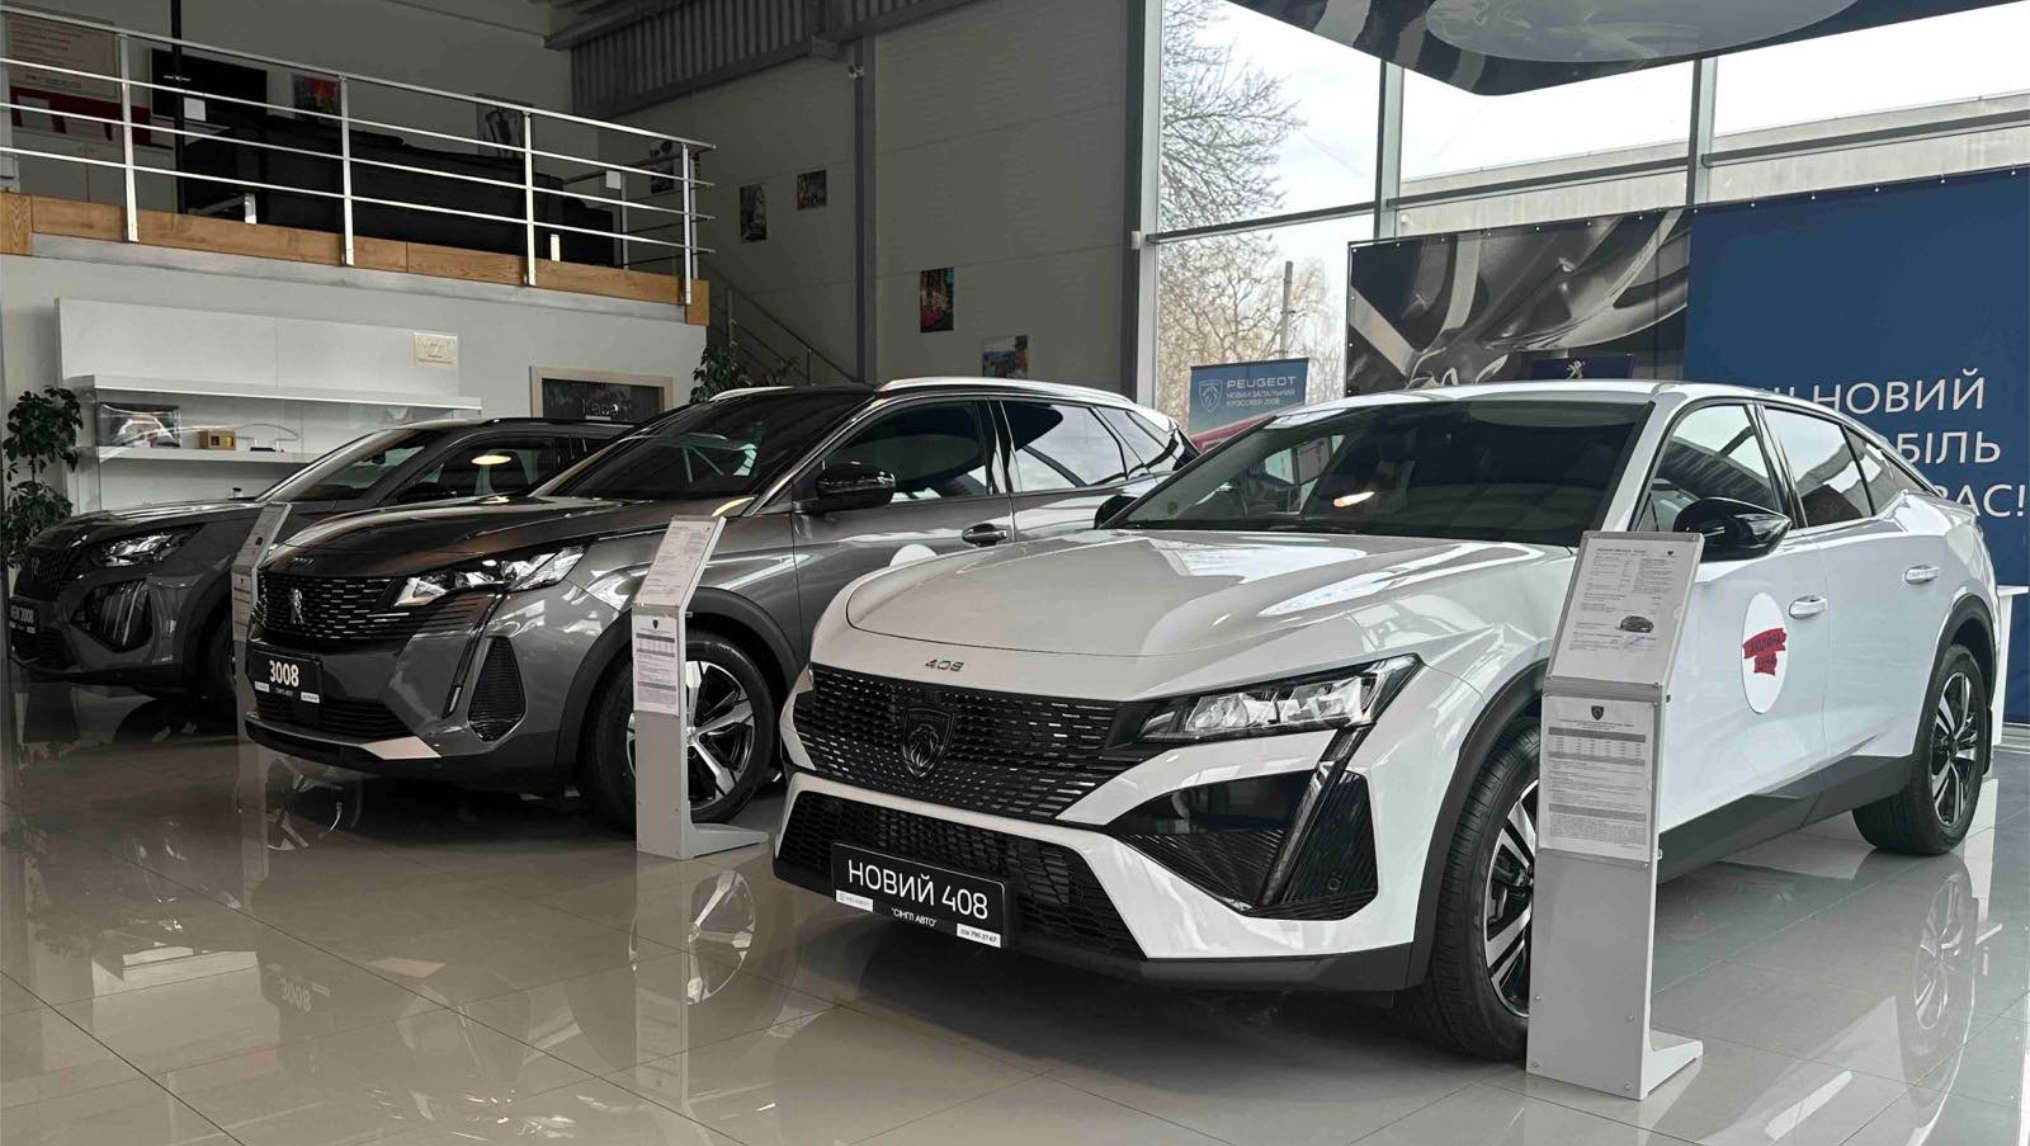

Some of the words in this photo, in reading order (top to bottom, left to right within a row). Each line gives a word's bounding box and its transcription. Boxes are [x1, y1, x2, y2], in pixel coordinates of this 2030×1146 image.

[1226, 376, 1296, 389] PEUGEOT
[1812, 367, 1985, 415] НОВИЙ
[269, 660, 299, 687] 3008
[925, 659, 965, 672] 408
[848, 859, 935, 906] НОВИЙ
[941, 885, 988, 920] 408
